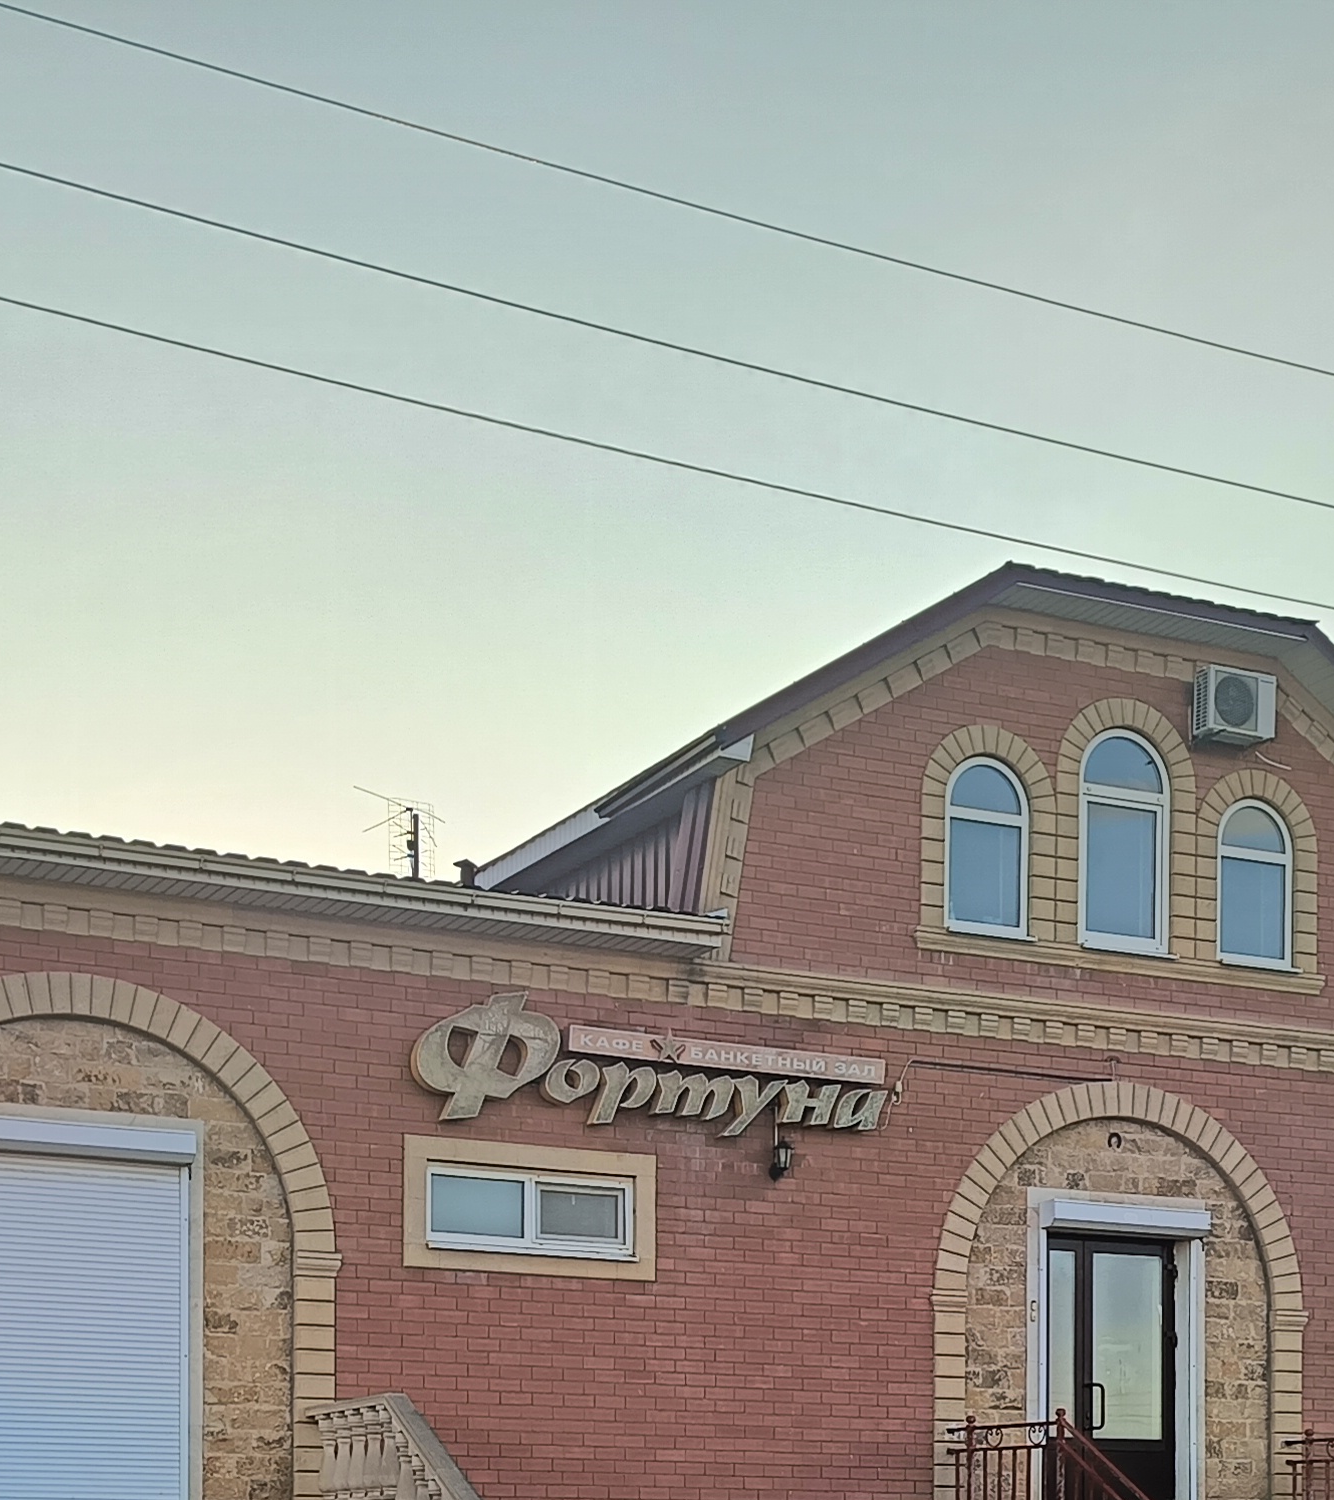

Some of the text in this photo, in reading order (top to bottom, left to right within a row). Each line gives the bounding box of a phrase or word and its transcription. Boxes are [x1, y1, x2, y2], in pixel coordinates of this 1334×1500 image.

[410, 989, 891, 1139] Фортуна
[579, 1033, 877, 1078] КАФЕ БАНКЕТНЫЙ ЗАЛ
